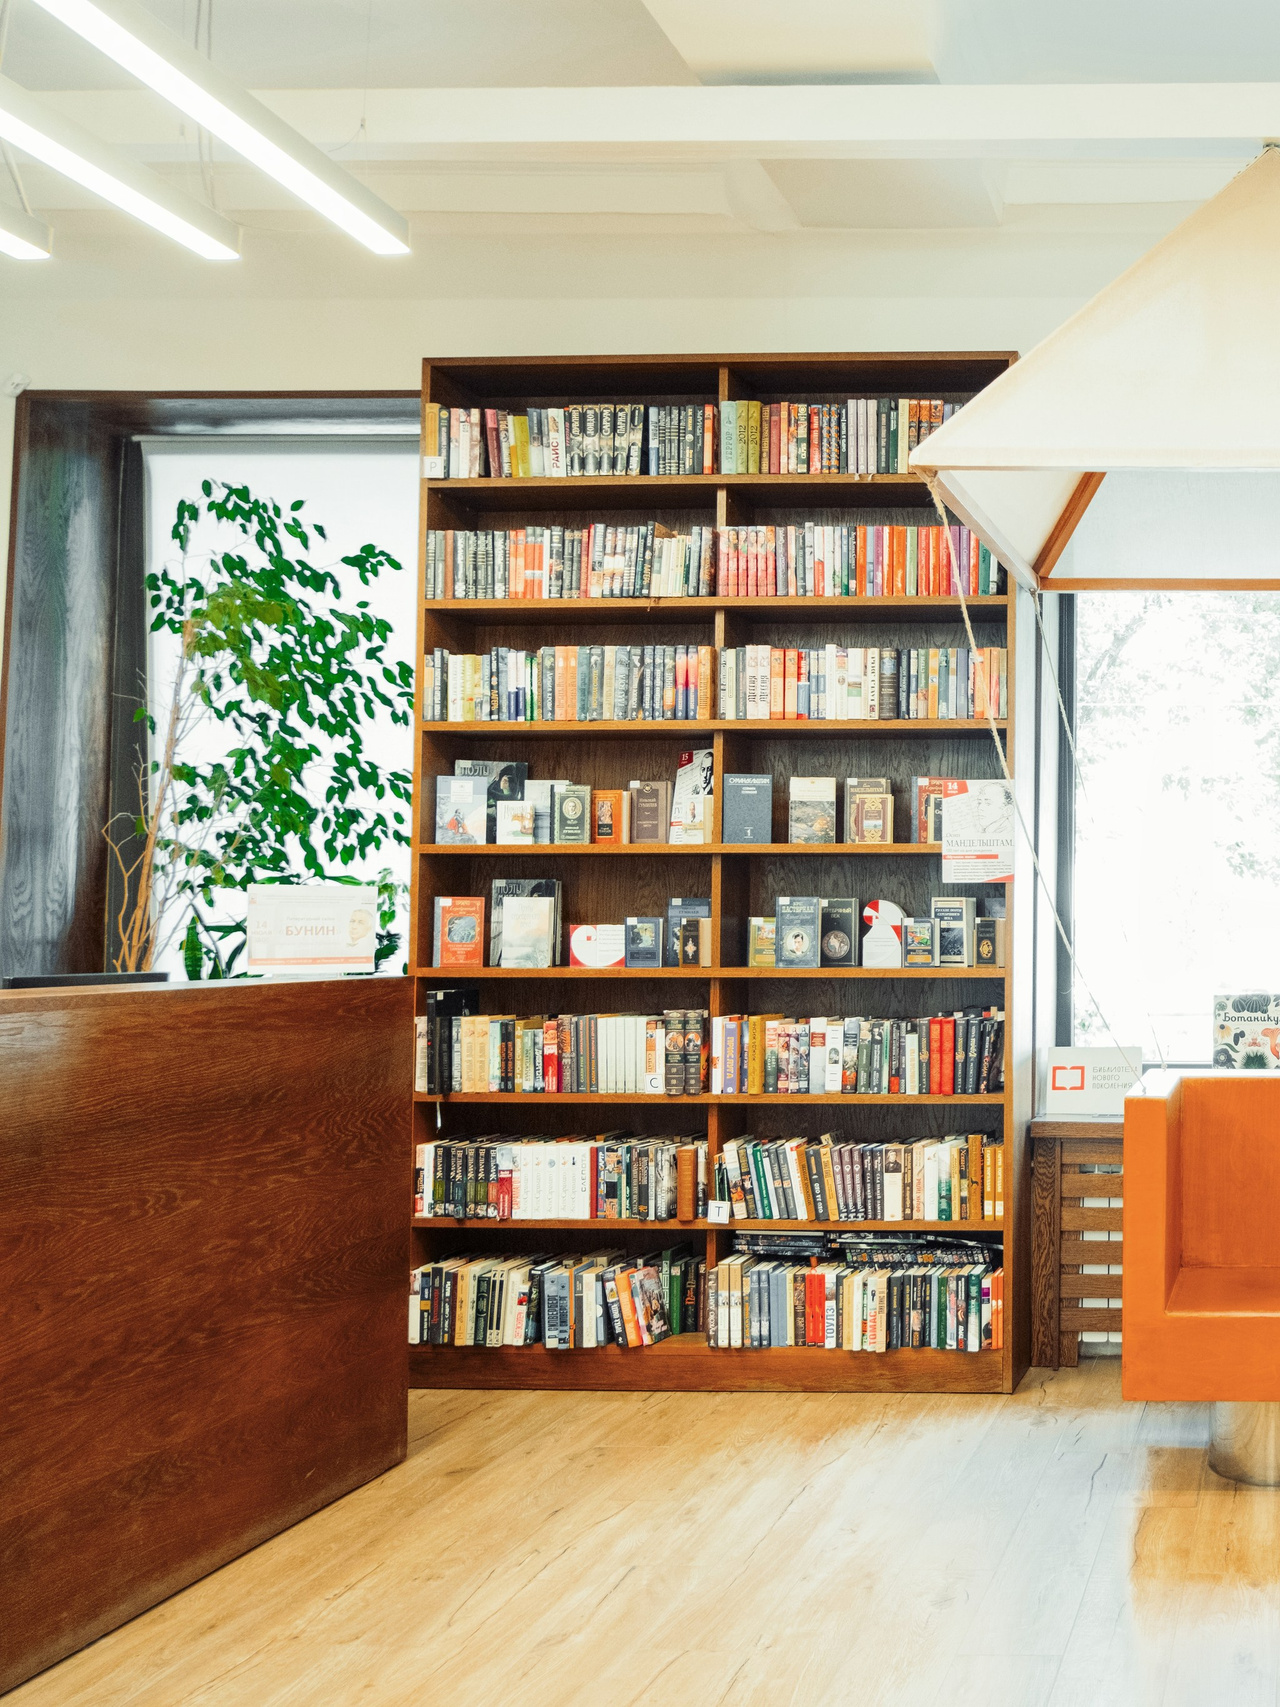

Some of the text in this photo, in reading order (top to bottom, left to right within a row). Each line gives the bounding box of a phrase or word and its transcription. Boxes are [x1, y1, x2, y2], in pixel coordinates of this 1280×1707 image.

[571, 409, 580, 436] ДУБЛИН
[586, 409, 595, 436] ЛОНДОН
[602, 409, 610, 436] САРУМ
[617, 411, 626, 434] ПАРИЖ
[738, 425, 746, 445] 2012
[750, 425, 758, 445] 2012
[429, 461, 438, 472] Р
[947, 782, 958, 790] 14
[946, 839, 1013, 847] МАНДЕЛЬШТАМ
[285, 925, 336, 936] БУНИН
[726, 1036, 734, 1079] ПРИСЛУГА
[649, 1077, 658, 1089] С
[1092, 1074, 1121, 1082] НОВОГО
[1092, 1082, 1133, 1090] ПОКОЛЕНИЯ
[436, 1147, 444, 1178] ВЕДЬМАК
[455, 1149, 463, 1180] ВЕДЬМАК
[467, 1148, 475, 1179] ВЕДЬМАК
[478, 1148, 486, 1180] ВЕДЬМАК
[836, 1183, 844, 1210] КОРОЛЕВЫ
[715, 1206, 723, 1217] Т
[825, 1308, 835, 1341] ТОУЛЗ
[868, 1311, 877, 1346] ТОМАС
